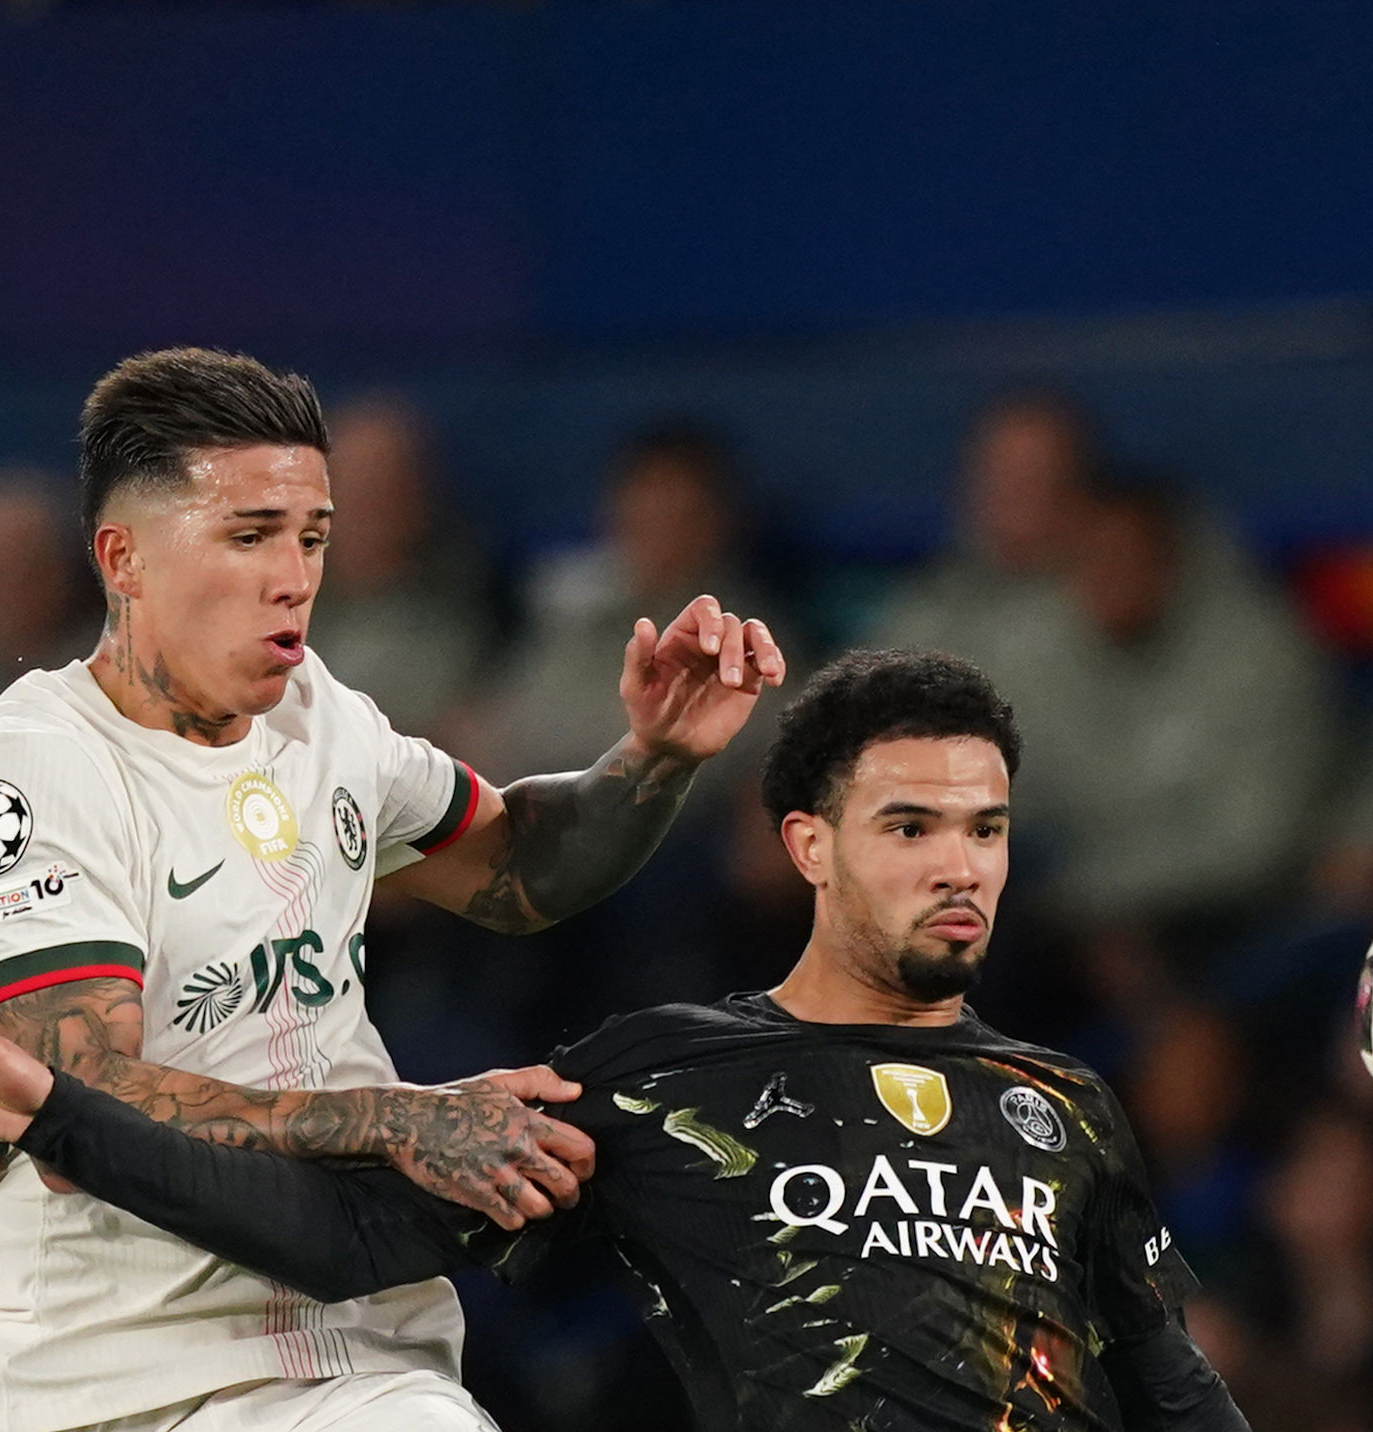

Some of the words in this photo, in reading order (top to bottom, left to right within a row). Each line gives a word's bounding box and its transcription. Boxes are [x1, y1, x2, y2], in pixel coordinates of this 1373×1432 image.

[240, 780, 289, 821] CHAMPIONS
[259, 837, 289, 856] FIFA
[769, 1154, 1059, 1250] QATAR
[860, 1220, 1060, 1283] AIRWAYS
